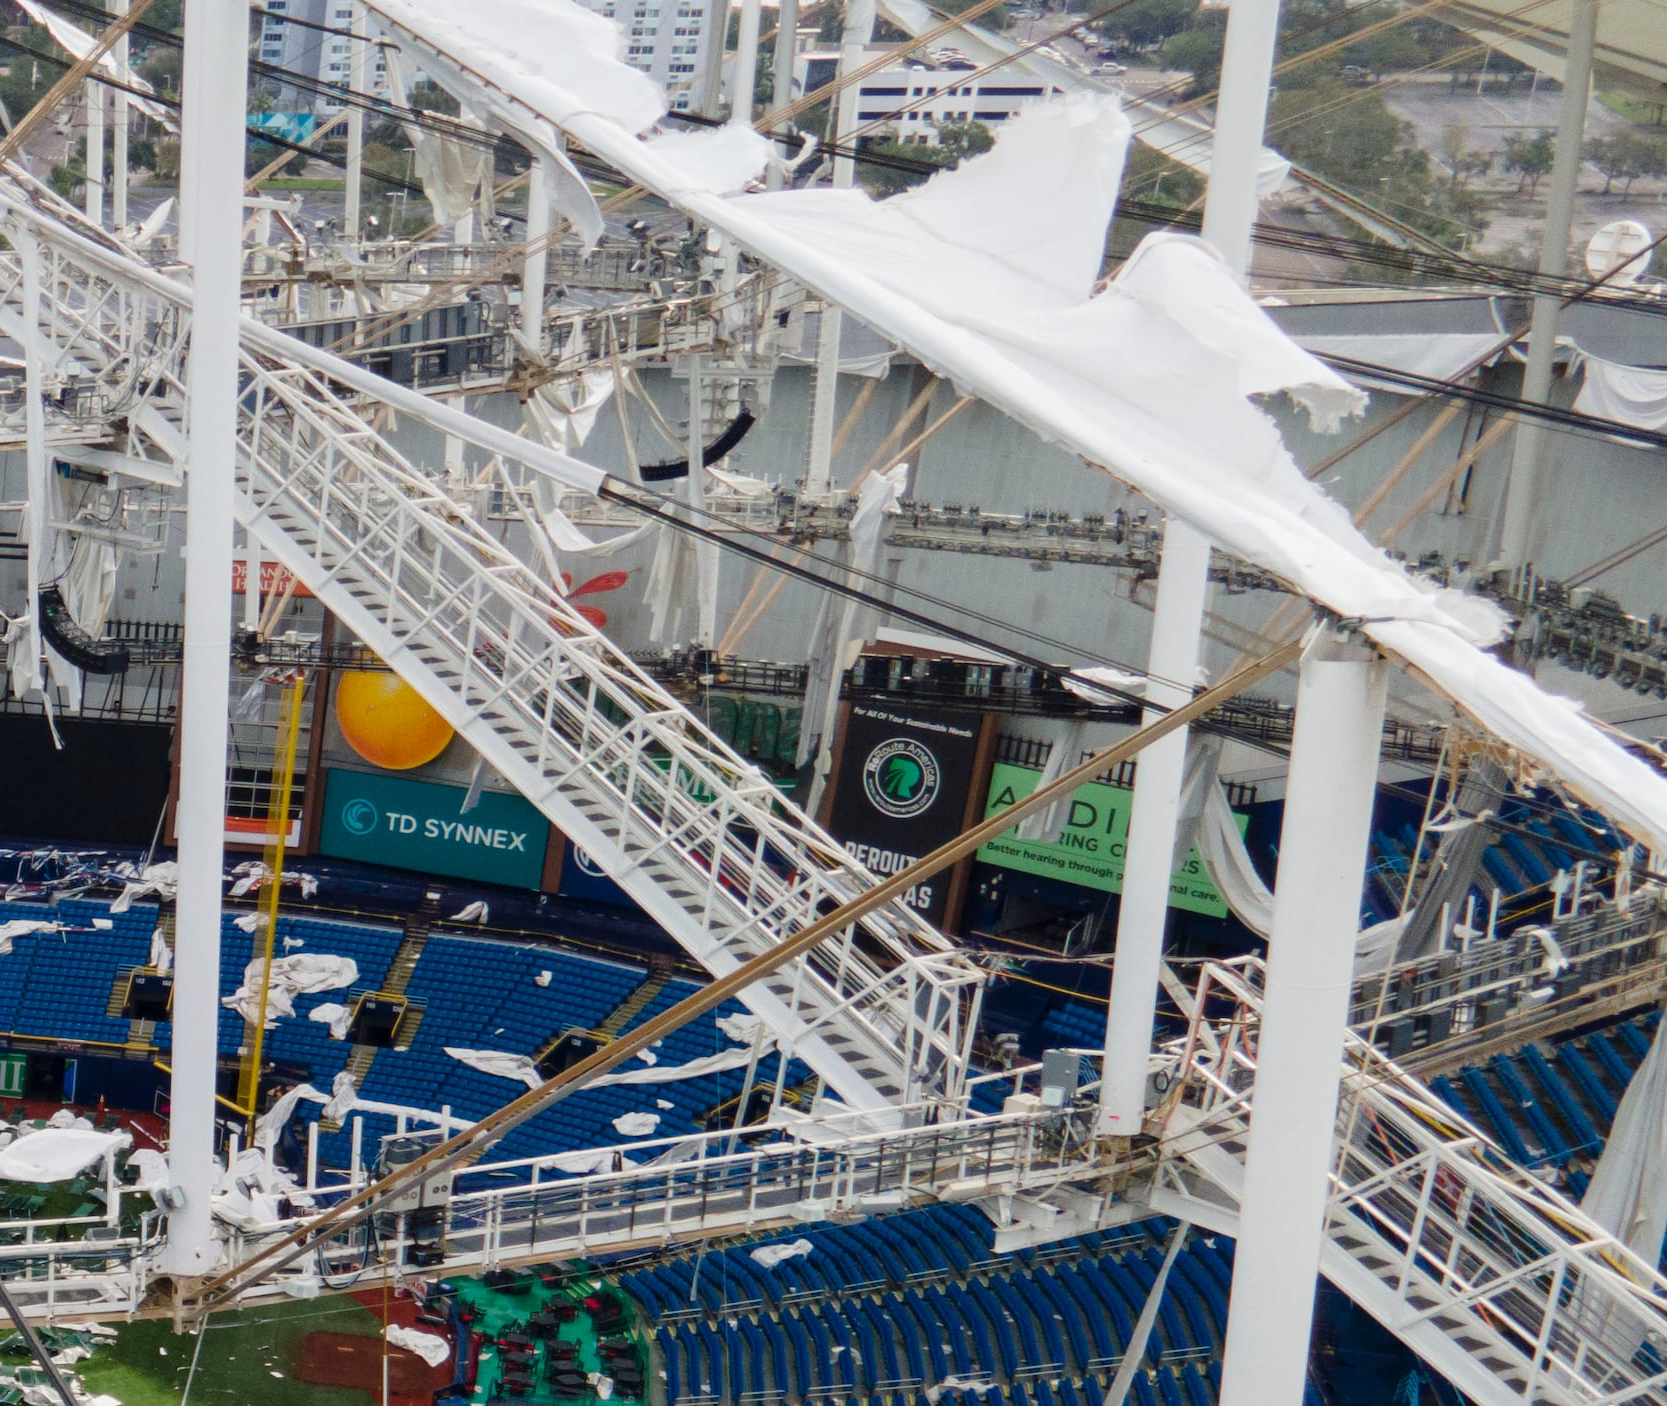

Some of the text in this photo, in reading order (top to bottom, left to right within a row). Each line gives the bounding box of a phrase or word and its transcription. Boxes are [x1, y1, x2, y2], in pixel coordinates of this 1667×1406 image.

[385, 811, 528, 852] TD SYNNEX
[986, 841, 1020, 857] Better
[1023, 848, 1065, 868] hearing
[1068, 859, 1114, 879] through
